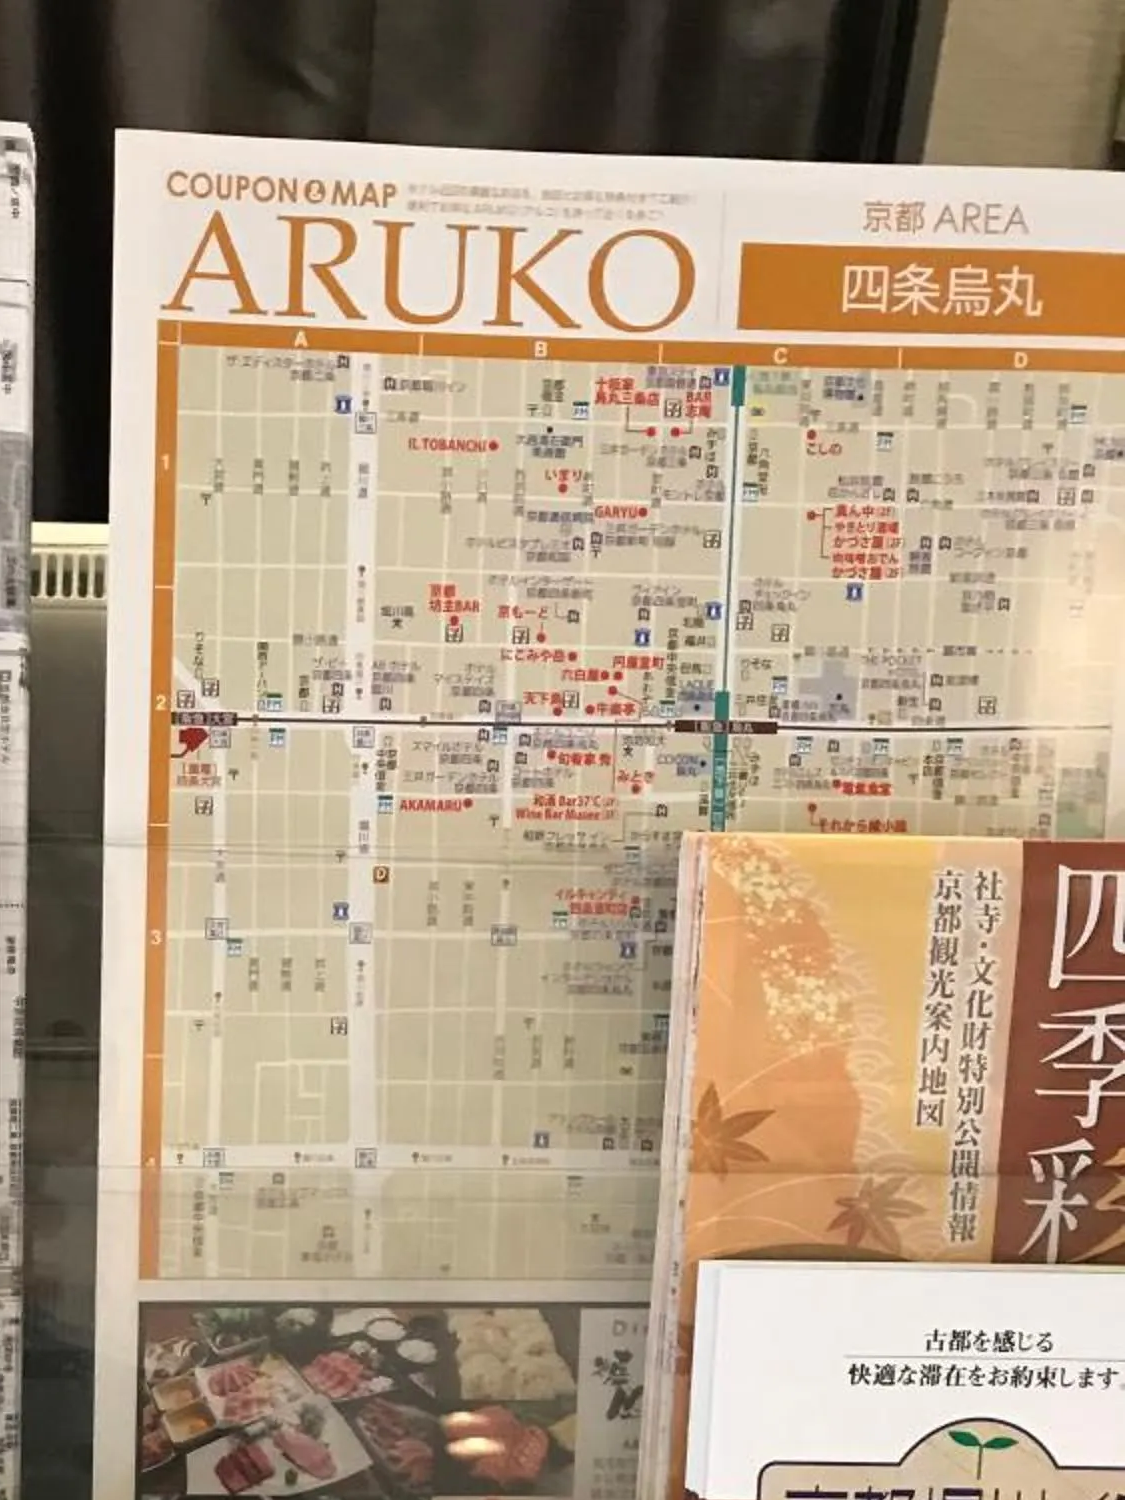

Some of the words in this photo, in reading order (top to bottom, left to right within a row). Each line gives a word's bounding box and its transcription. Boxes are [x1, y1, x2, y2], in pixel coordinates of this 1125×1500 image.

[166, 170, 297, 203] COUPON
[330, 180, 397, 208] MAP
[863, 201, 924, 235] 京都
[933, 201, 1030, 236] AREA
[160, 209, 695, 333] ARUKO
[841, 263, 1042, 319] 四条烏丸
[915, 869, 965, 1128] 京都観光案内地図
[948, 868, 1004, 1242] 社寺・文化財特別公開情報
[924, 1328, 1055, 1354] 古都を感じる
